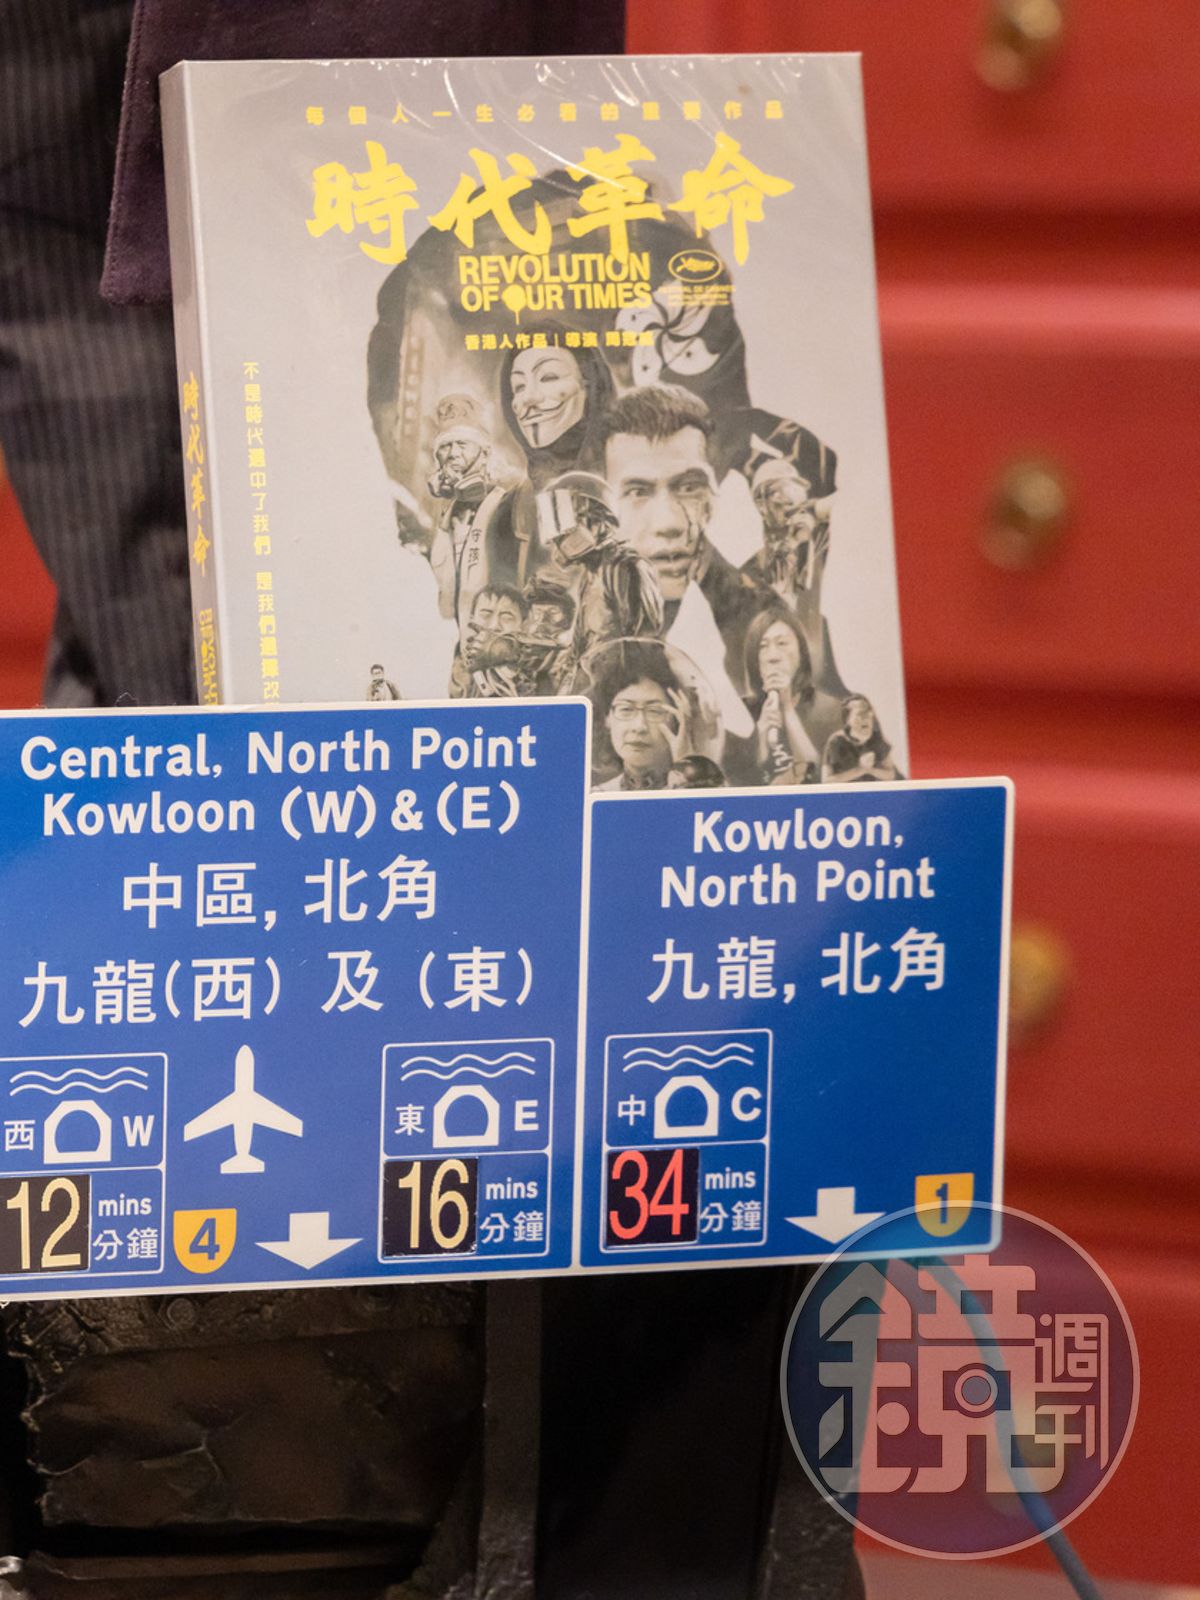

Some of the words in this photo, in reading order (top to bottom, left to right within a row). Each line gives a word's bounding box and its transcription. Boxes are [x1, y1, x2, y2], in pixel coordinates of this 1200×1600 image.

[305, 130, 795, 267] 時代革命
[458, 251, 650, 286] REVOLUTION
[460, 285, 501, 313] OF
[567, 283, 652, 310] TIMES
[464, 333, 548, 351] 香港人作品
[255, 571, 281, 705] 是我們選擇改
[20, 732, 223, 782] Central,
[247, 729, 391, 775] North
[412, 724, 538, 770] Point
[42, 791, 256, 837] Kowloon
[280, 785, 377, 841] (W)
[390, 792, 424, 832] &
[437, 780, 520, 836] (E)
[693, 808, 904, 854] Kowloon,
[304, 854, 438, 925] 北角
[661, 862, 796, 908] North
[816, 856, 935, 902] Point
[820, 927, 946, 996] 北角
[321, 948, 385, 1015] 及
[395, 1103, 426, 1136] 東
[514, 1099, 540, 1132] E
[617, 1094, 647, 1127] 中
[730, 1087, 762, 1122] C
[3, 1120, 37, 1153] 西
[122, 1115, 155, 1147] W
[485, 1177, 539, 1201] mins
[609, 1149, 690, 1240] 34
[704, 1169, 756, 1190] mins
[98, 1194, 152, 1217] mins
[398, 1158, 470, 1250] 16
[699, 1200, 762, 1233] 分鐘
[934, 1182, 950, 1225] 1
[6, 1177, 82, 1271] 12
[188, 1217, 221, 1262] 4
[478, 1210, 545, 1245] 分鐘
[92, 1227, 159, 1262] 分鐘
